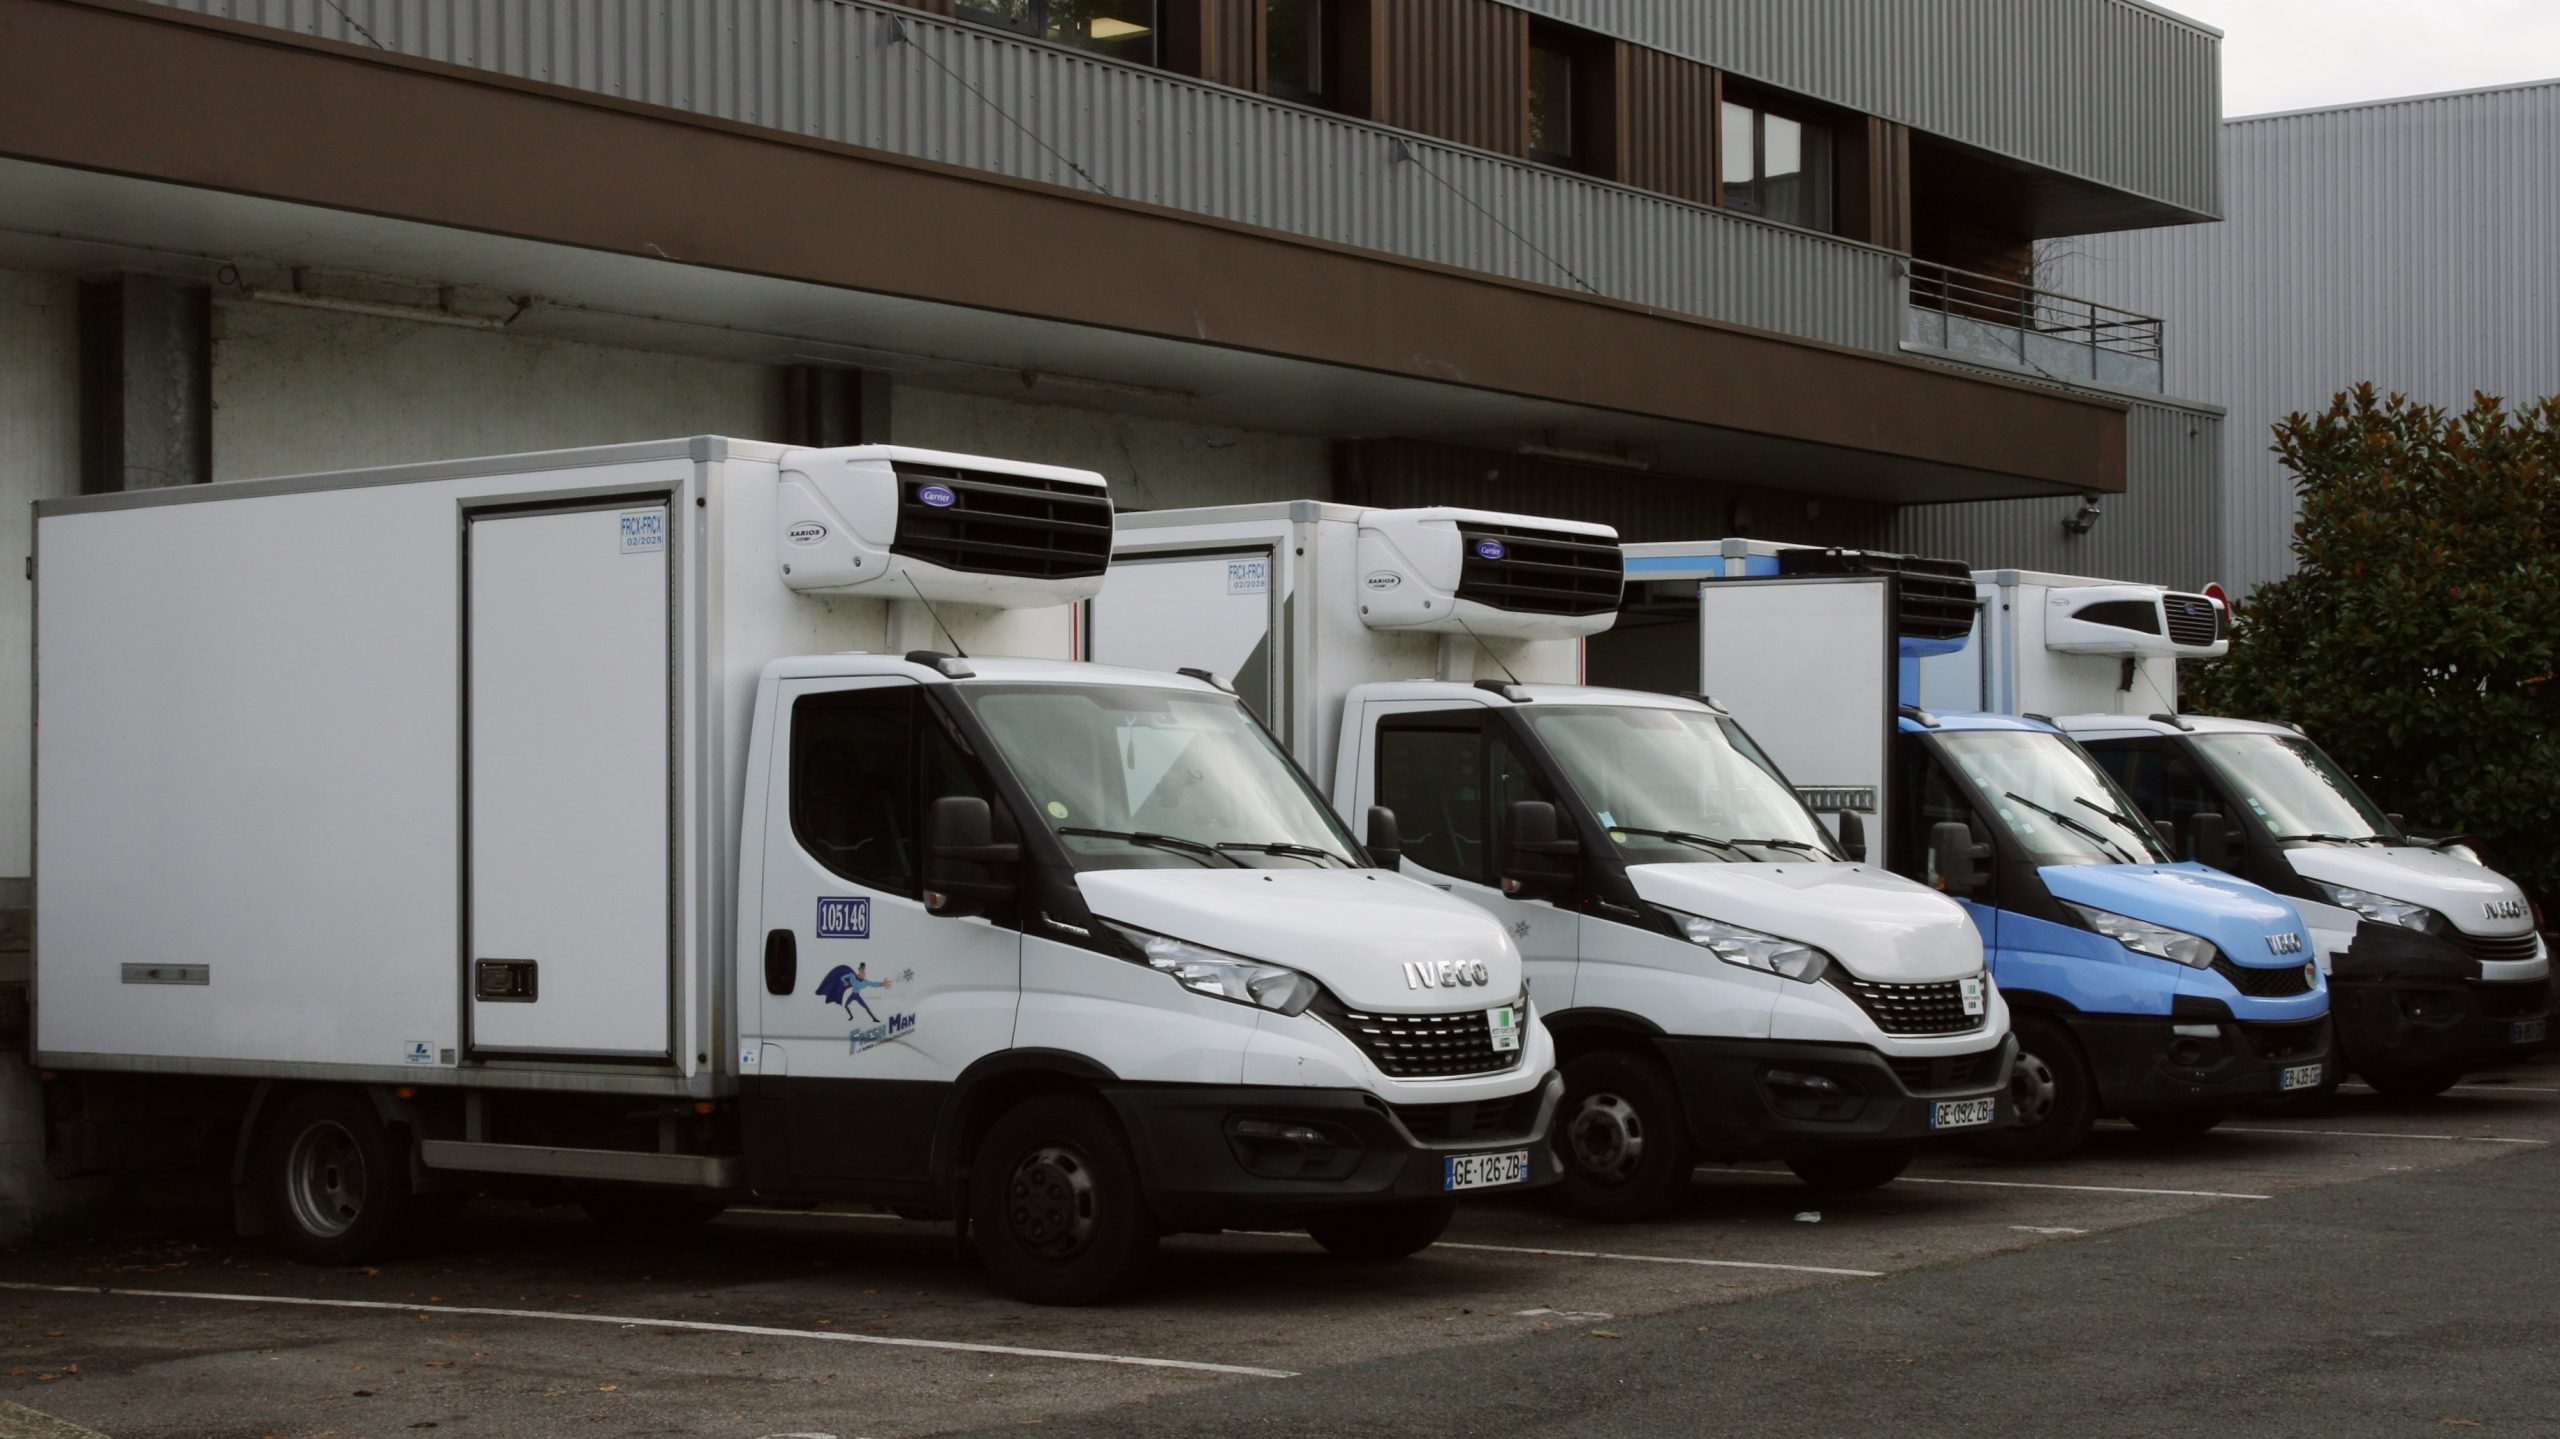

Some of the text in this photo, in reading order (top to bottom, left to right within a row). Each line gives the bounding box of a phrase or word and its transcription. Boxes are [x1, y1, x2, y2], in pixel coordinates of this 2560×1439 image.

[924, 491, 950, 502] Carrier
[790, 529, 820, 537] XARIOS
[821, 903, 866, 931] 105146
[2481, 901, 2521, 919] IVECO
[1401, 959, 1489, 991] IVECO
[1936, 1100, 1989, 1126] GE-092-ZB
[1454, 1155, 1520, 1186] GE-126-ZB
